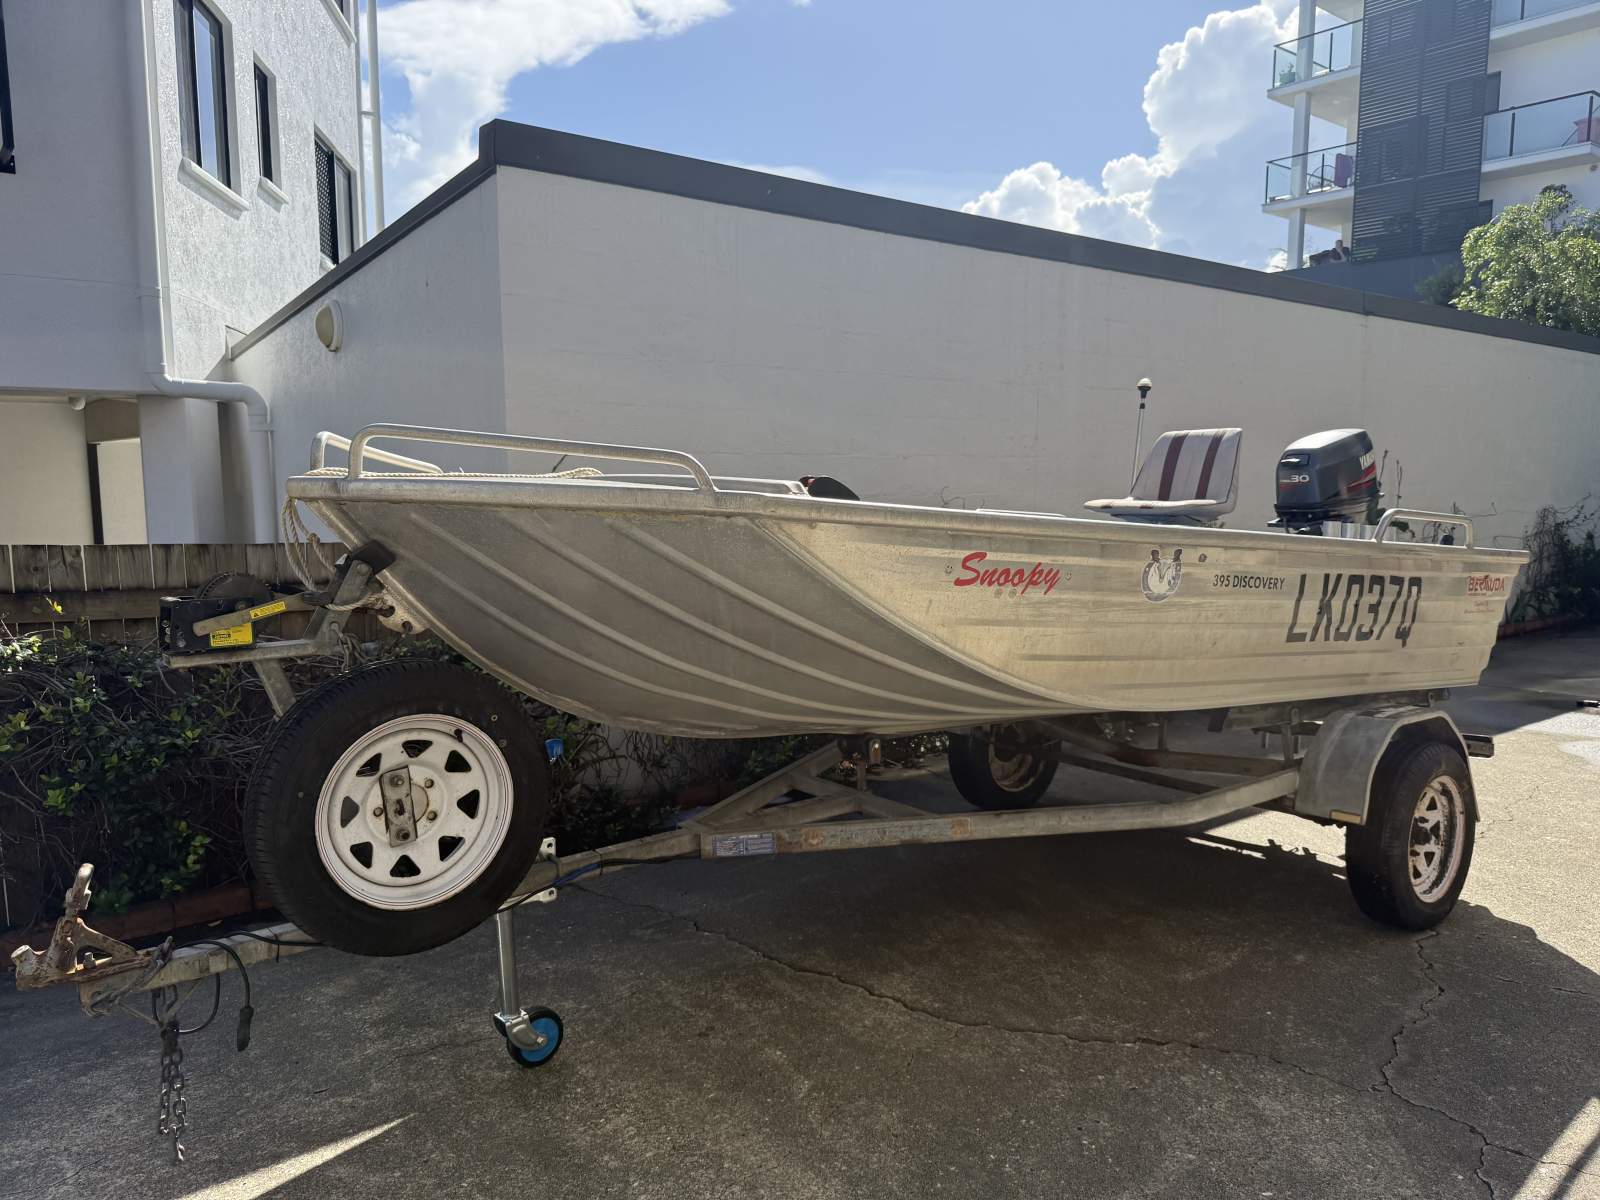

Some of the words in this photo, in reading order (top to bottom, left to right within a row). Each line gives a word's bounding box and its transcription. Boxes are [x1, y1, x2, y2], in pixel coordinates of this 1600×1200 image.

[1290, 474, 1310, 483] 30
[955, 551, 1061, 595] Snoopy
[1213, 574, 1231, 587] 395
[1232, 575, 1285, 590] DISCOVERY
[1468, 576, 1505, 592] BERMUDA
